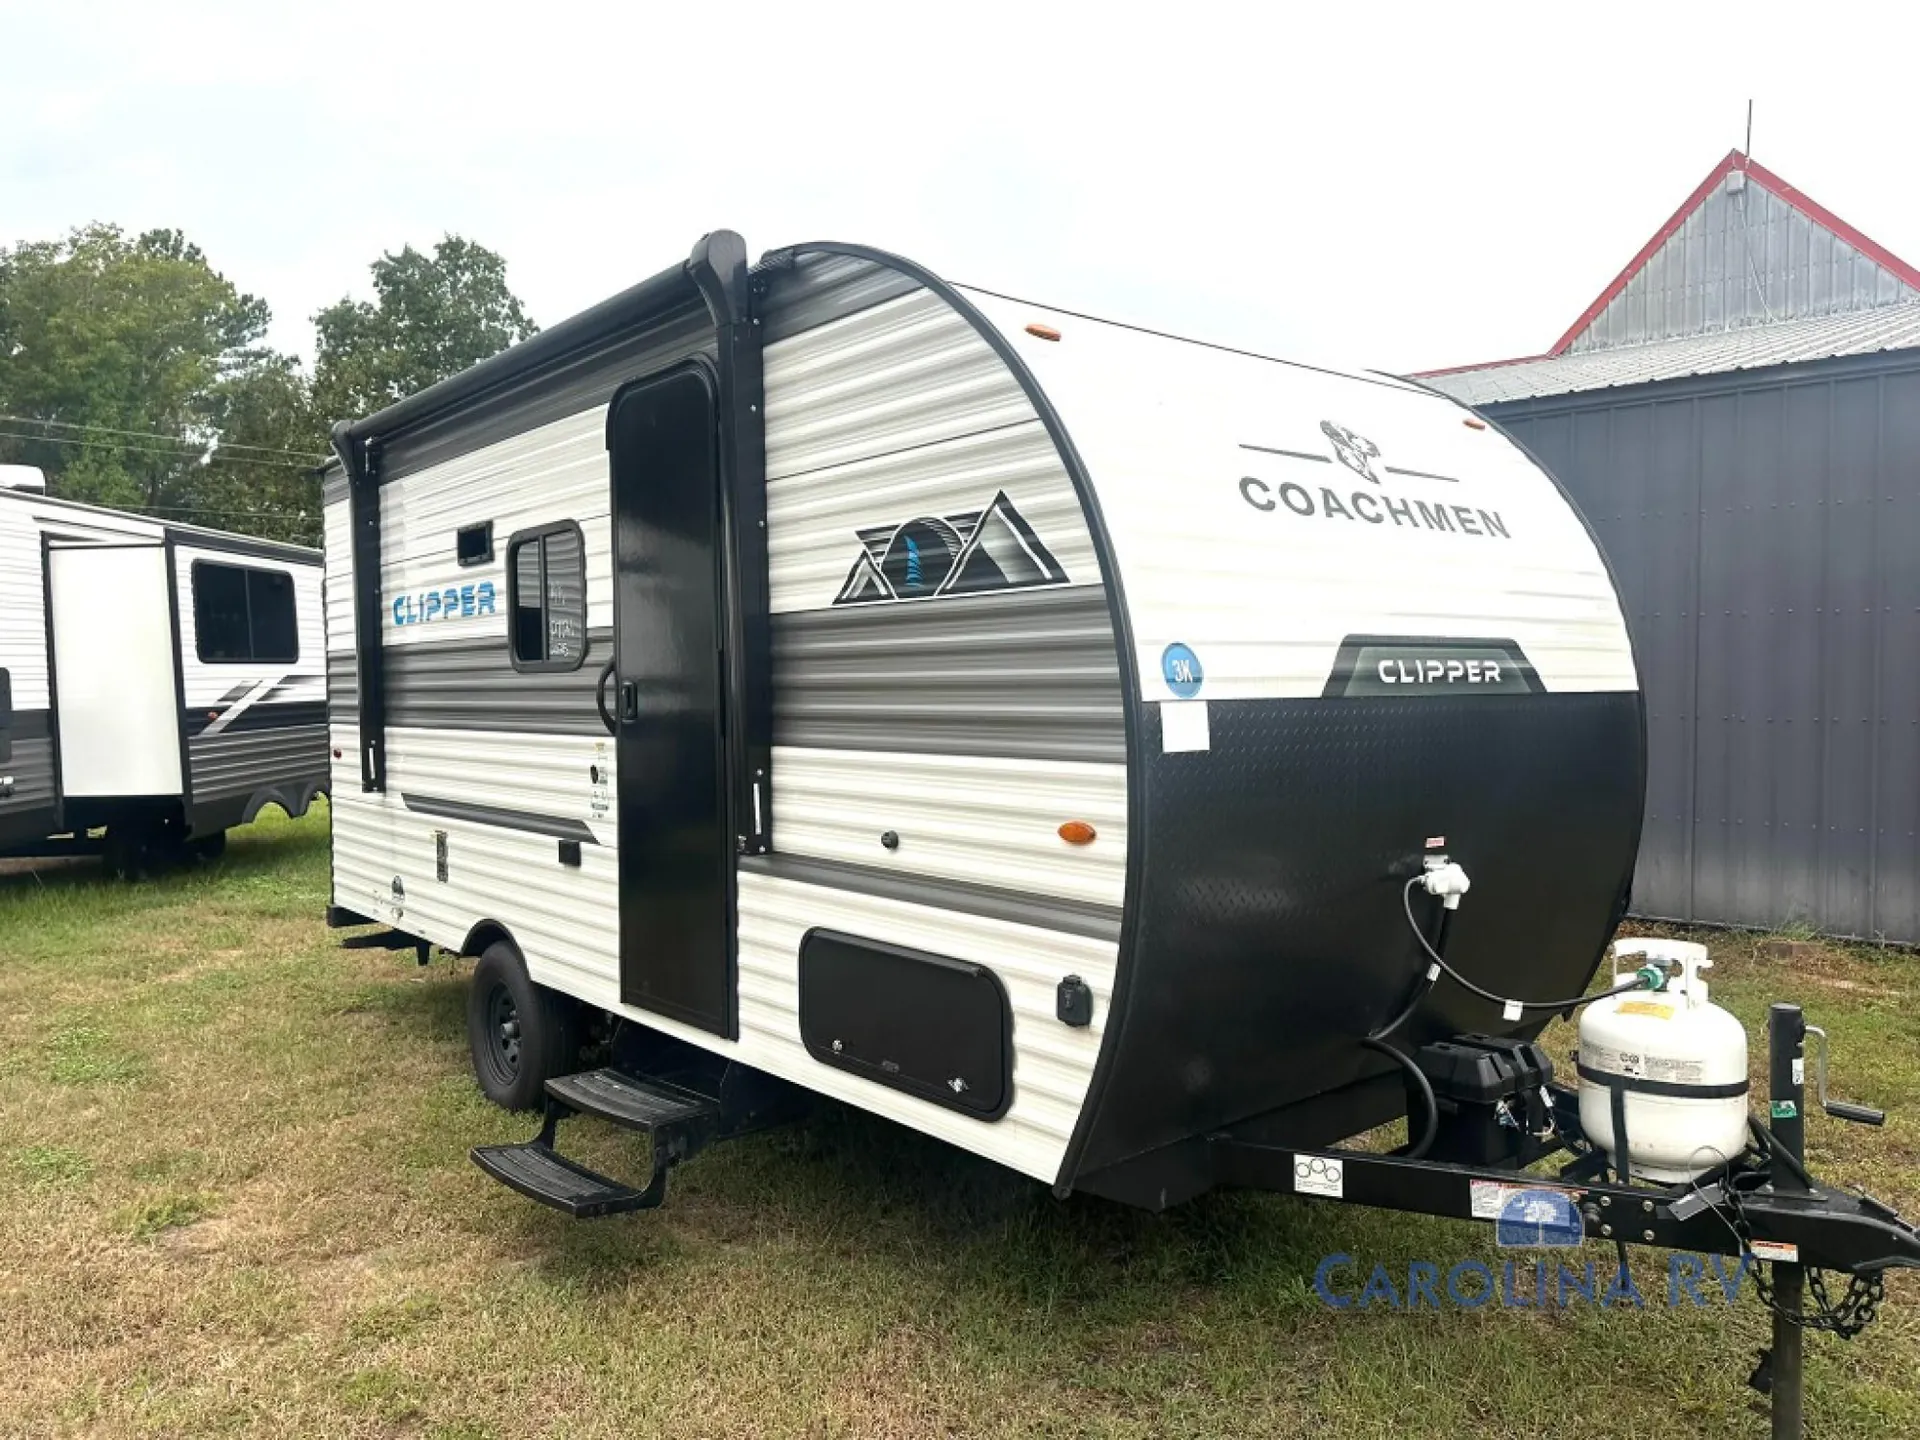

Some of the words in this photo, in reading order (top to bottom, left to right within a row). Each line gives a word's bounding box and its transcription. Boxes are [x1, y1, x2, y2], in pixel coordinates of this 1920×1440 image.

[1239, 477, 1512, 539] COACHMEN
[393, 582, 496, 625] CLIPPER
[1377, 658, 1502, 684] CLIPPER
